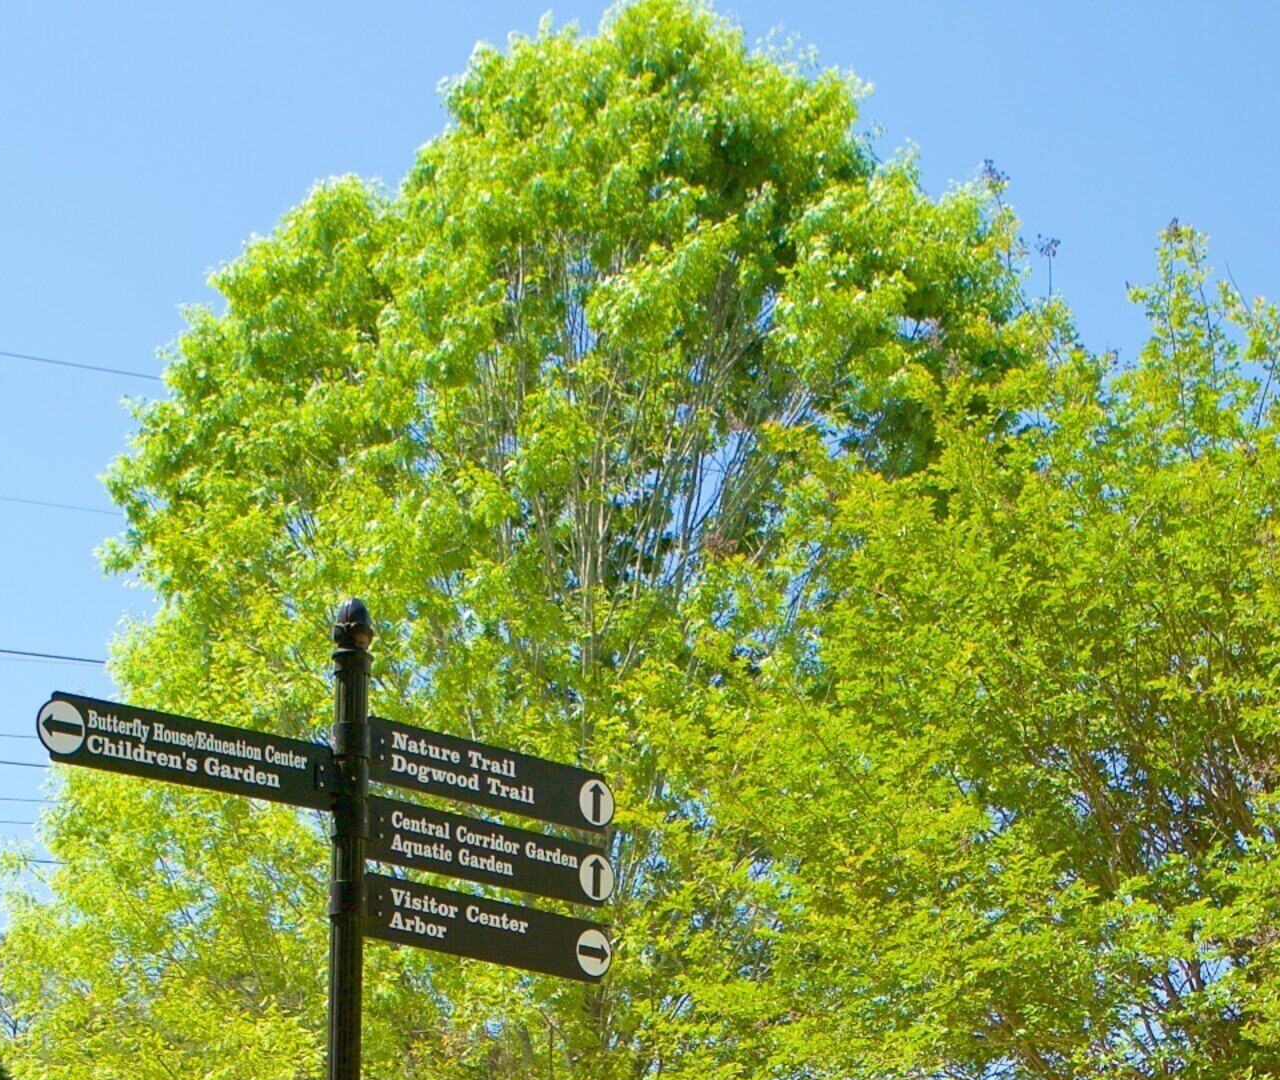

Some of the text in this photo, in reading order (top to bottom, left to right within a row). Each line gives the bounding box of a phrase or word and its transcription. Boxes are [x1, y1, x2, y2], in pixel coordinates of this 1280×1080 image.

[86, 735, 281, 788] Children's Garden
[87, 709, 308, 770] Butterfly House/Education Center
[391, 731, 516, 778] Nature Trail
[391, 754, 535, 804] Dogwood Trail
[390, 834, 514, 876] Aquatic Garden
[391, 811, 579, 869] Central Corridor Garden
[389, 912, 448, 939] Arbor
[390, 888, 529, 934] Visitor Center
